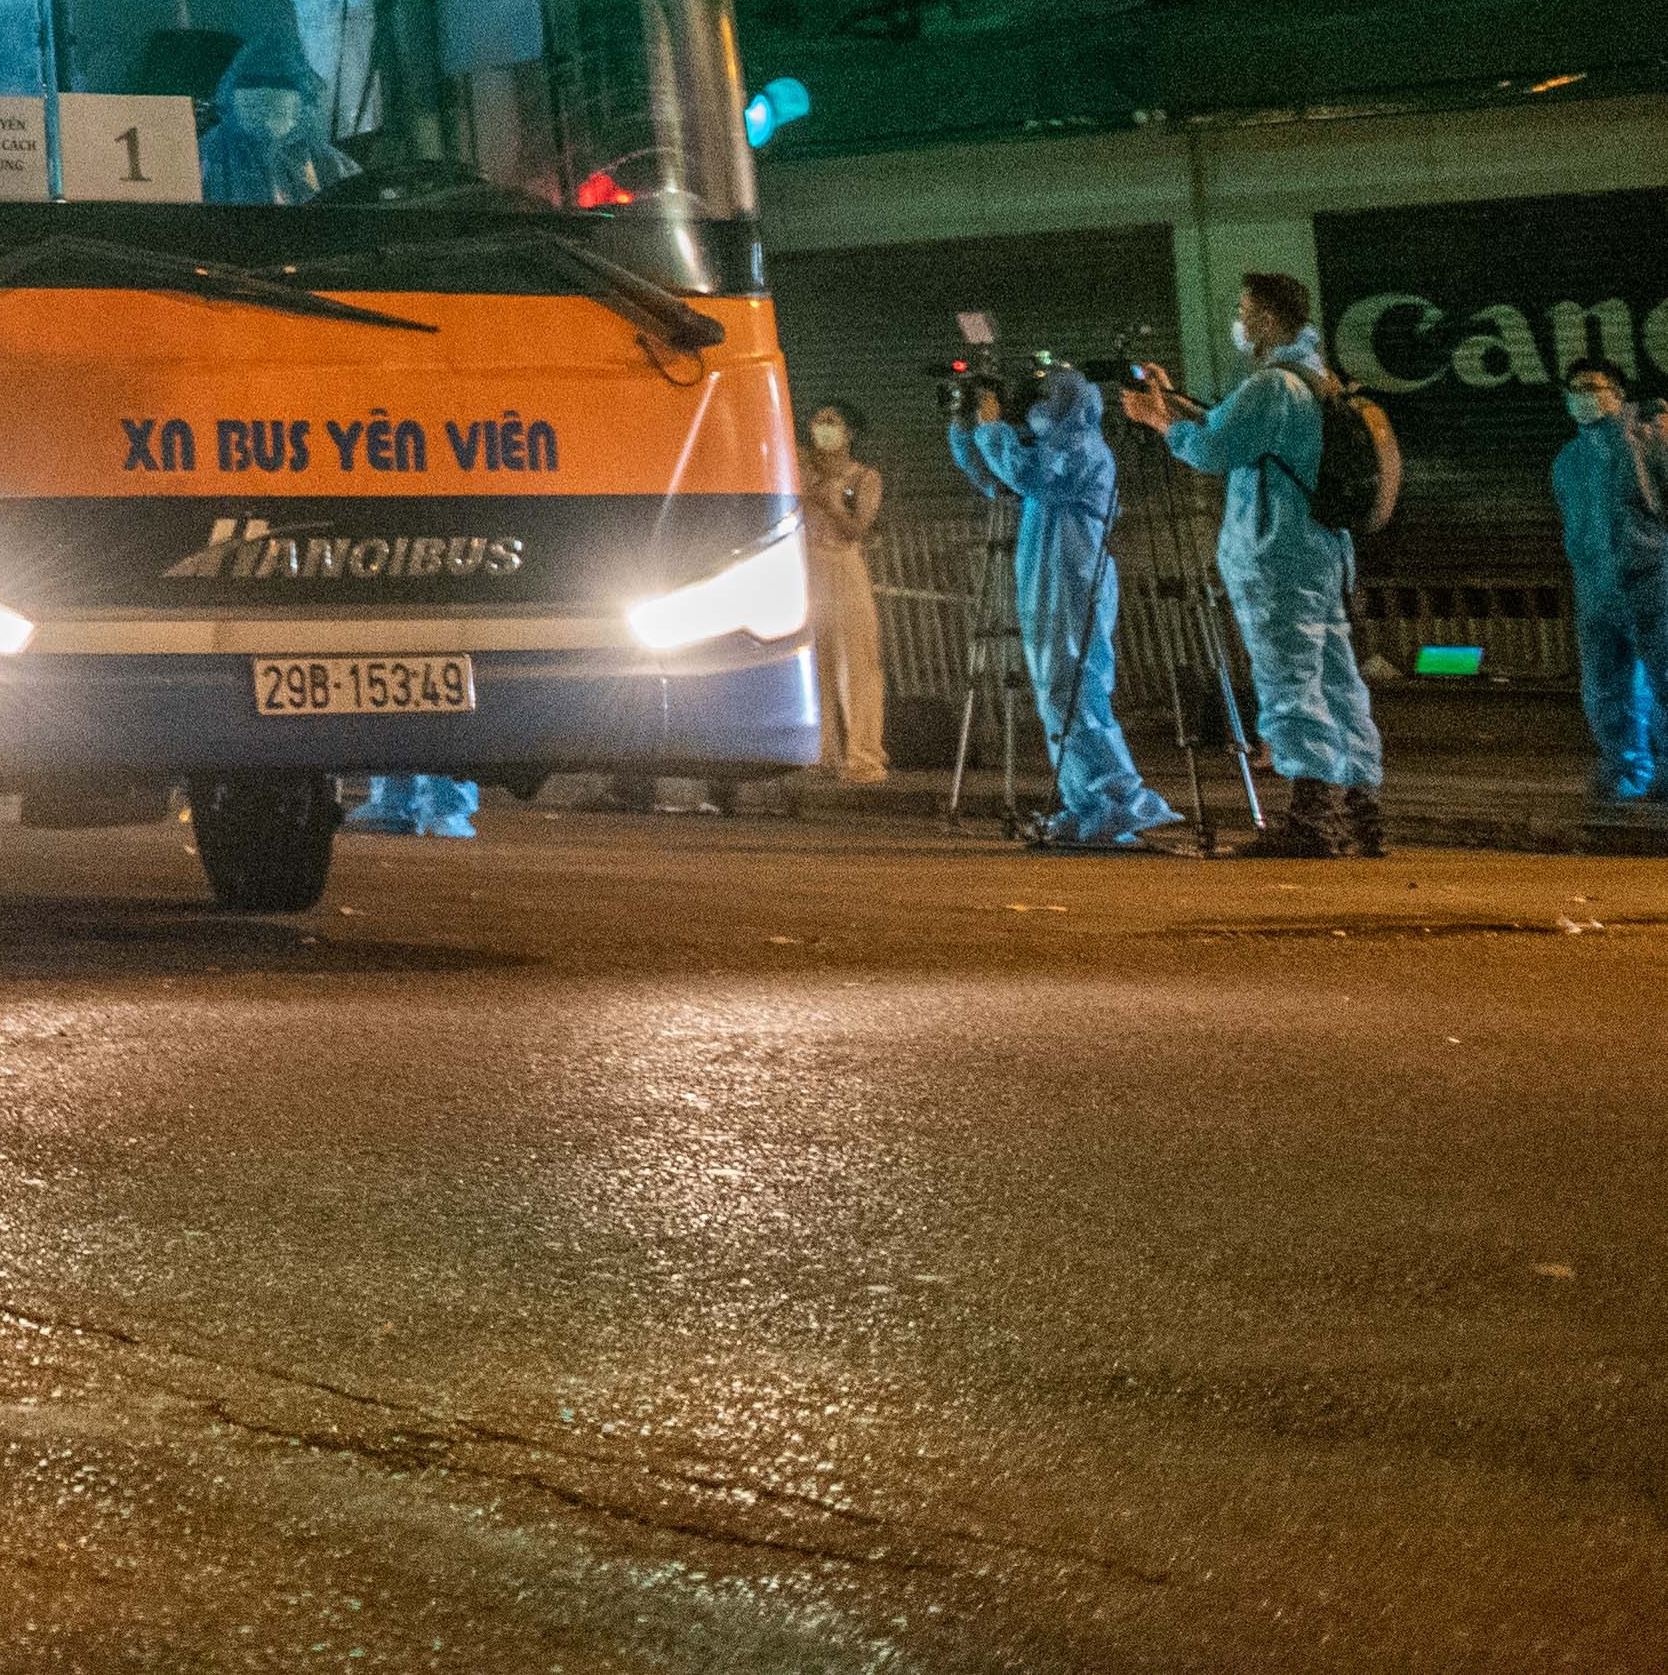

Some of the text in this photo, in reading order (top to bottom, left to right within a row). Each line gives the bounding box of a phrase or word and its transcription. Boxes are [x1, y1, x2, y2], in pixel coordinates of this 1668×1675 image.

[114, 127, 152, 183] 1
[216, 418, 311, 473] BUS
[326, 407, 428, 472] YÊN
[444, 409, 560, 472] VIÊN
